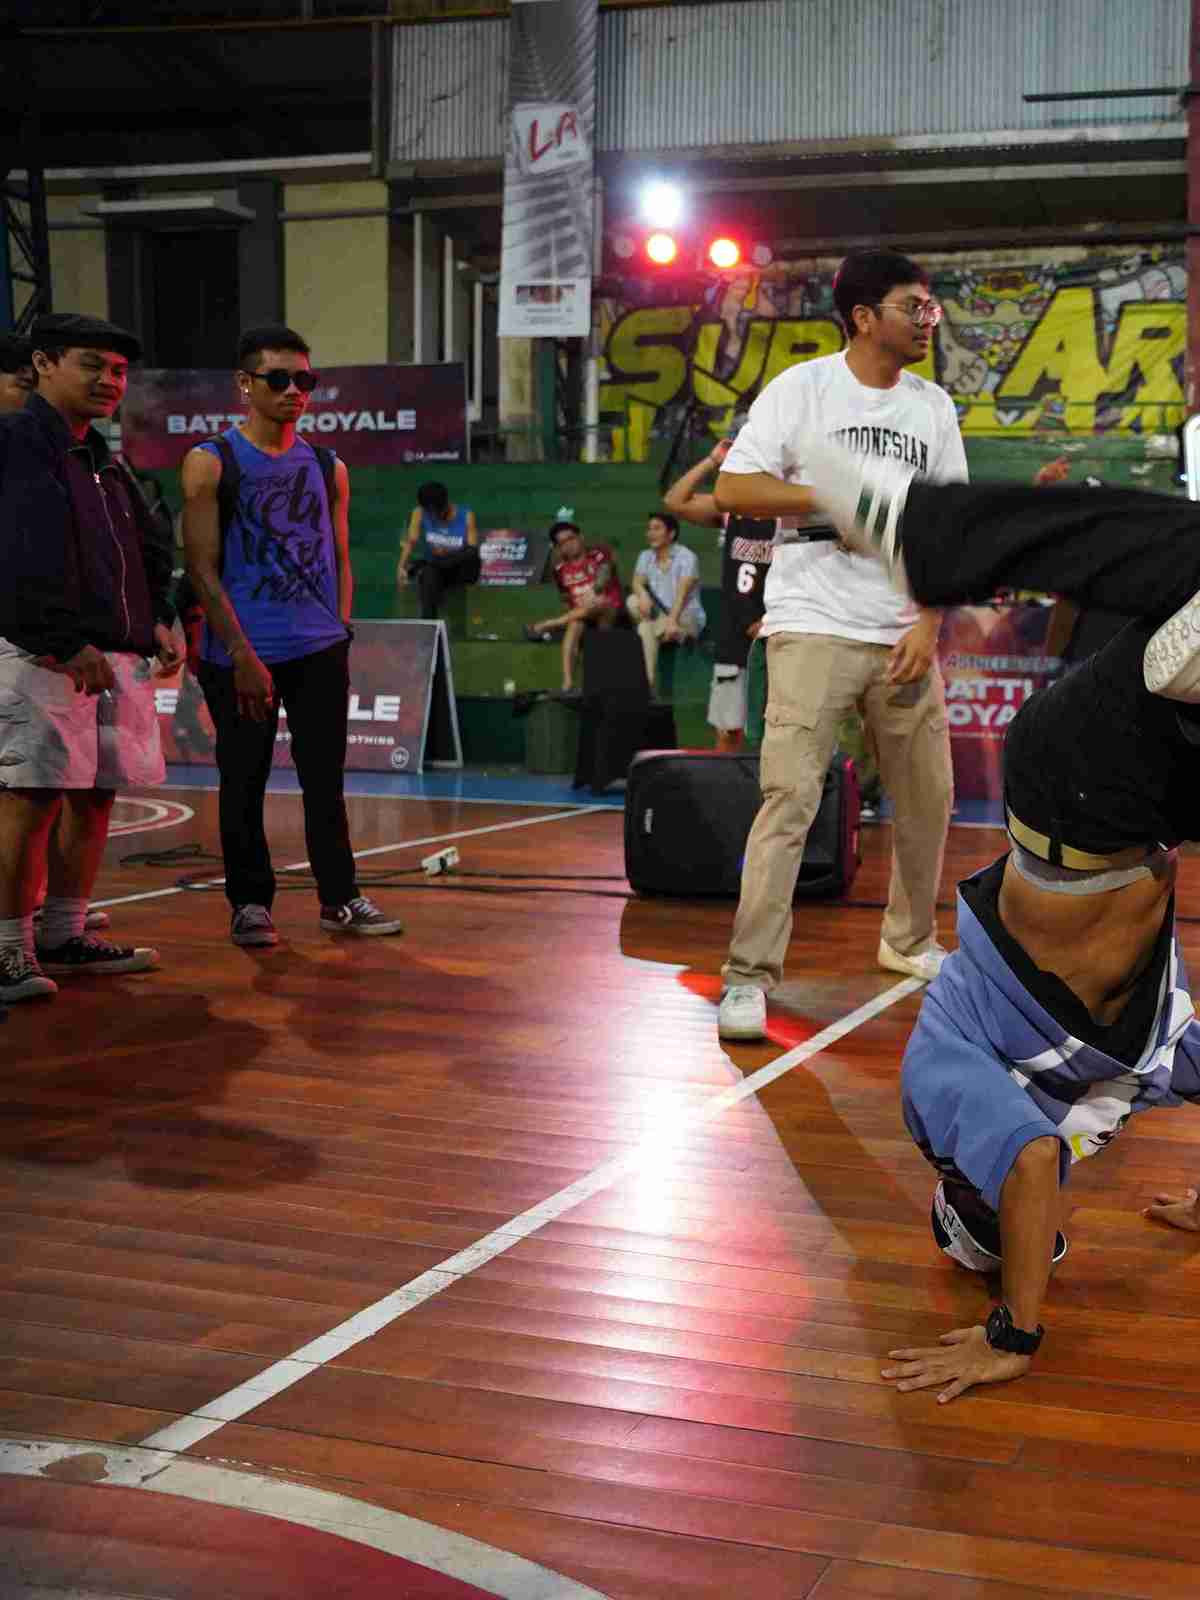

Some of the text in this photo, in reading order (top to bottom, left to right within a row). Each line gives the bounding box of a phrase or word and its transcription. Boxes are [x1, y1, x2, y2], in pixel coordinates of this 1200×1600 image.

[528, 112, 577, 161] LA
[167, 409, 417, 434] BATT ROYALE
[828, 426, 928, 473] NDONESIAN
[737, 562, 757, 593] 6
[944, 678, 1034, 700] ATT
[947, 703, 1018, 726] OYA
